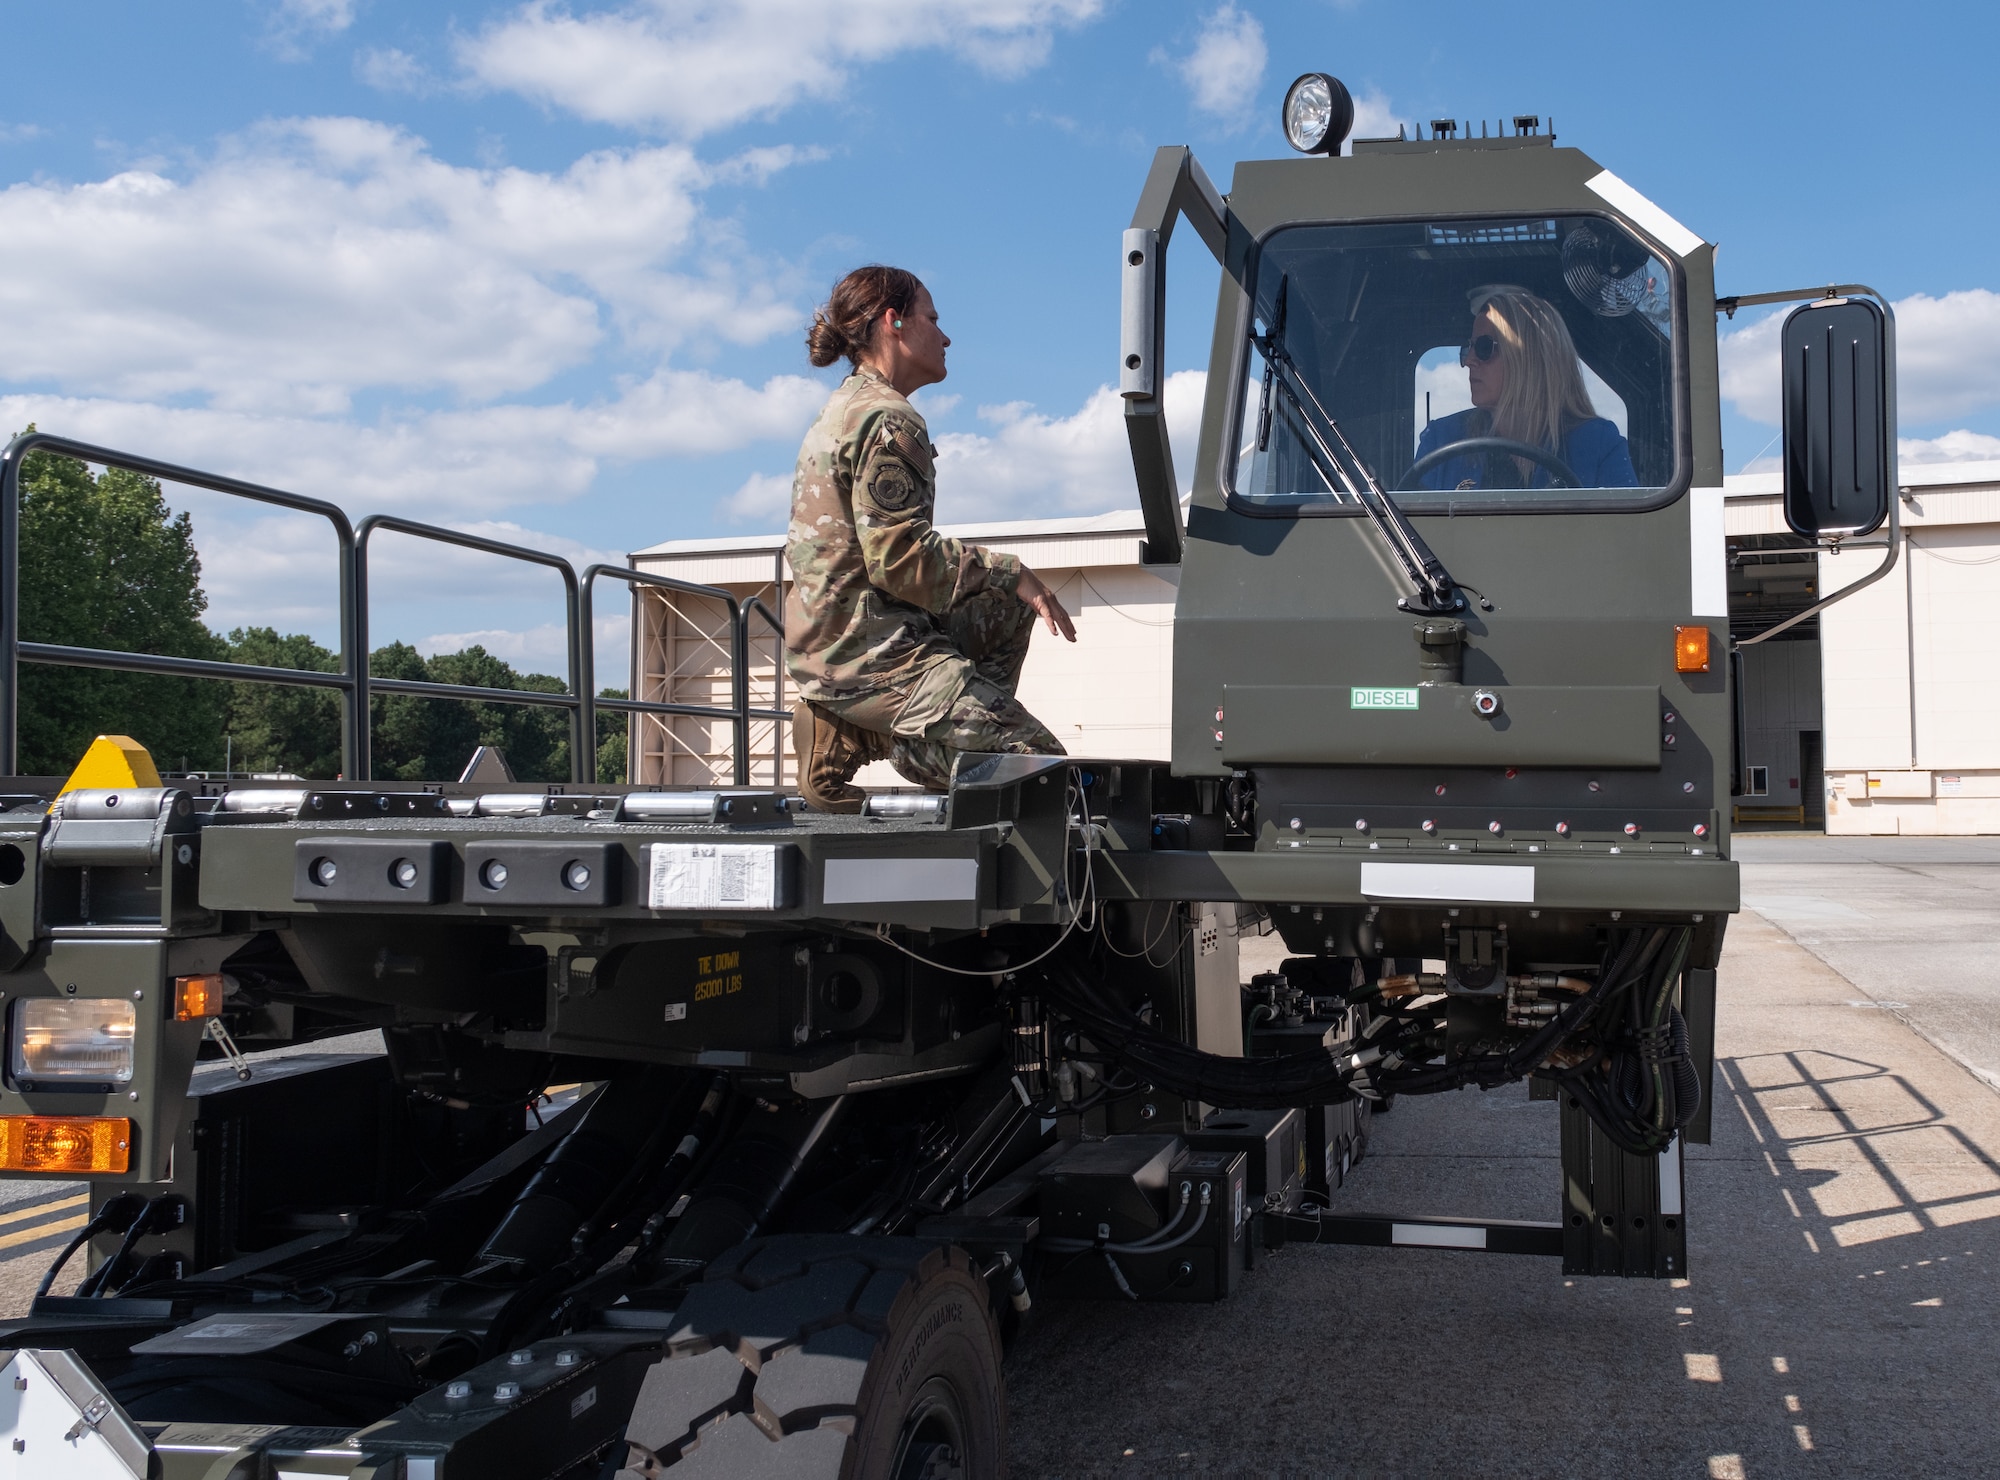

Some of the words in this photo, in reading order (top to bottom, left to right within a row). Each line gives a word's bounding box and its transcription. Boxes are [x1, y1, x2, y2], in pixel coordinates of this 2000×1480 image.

[1354, 691, 1415, 705] DIESEL
[698, 955, 712, 975] TIE
[715, 951, 740, 972] DOWN
[694, 977, 723, 1002] 25000
[726, 974, 742, 994] LBS
[896, 1303, 962, 1397] PERFORMANCE
